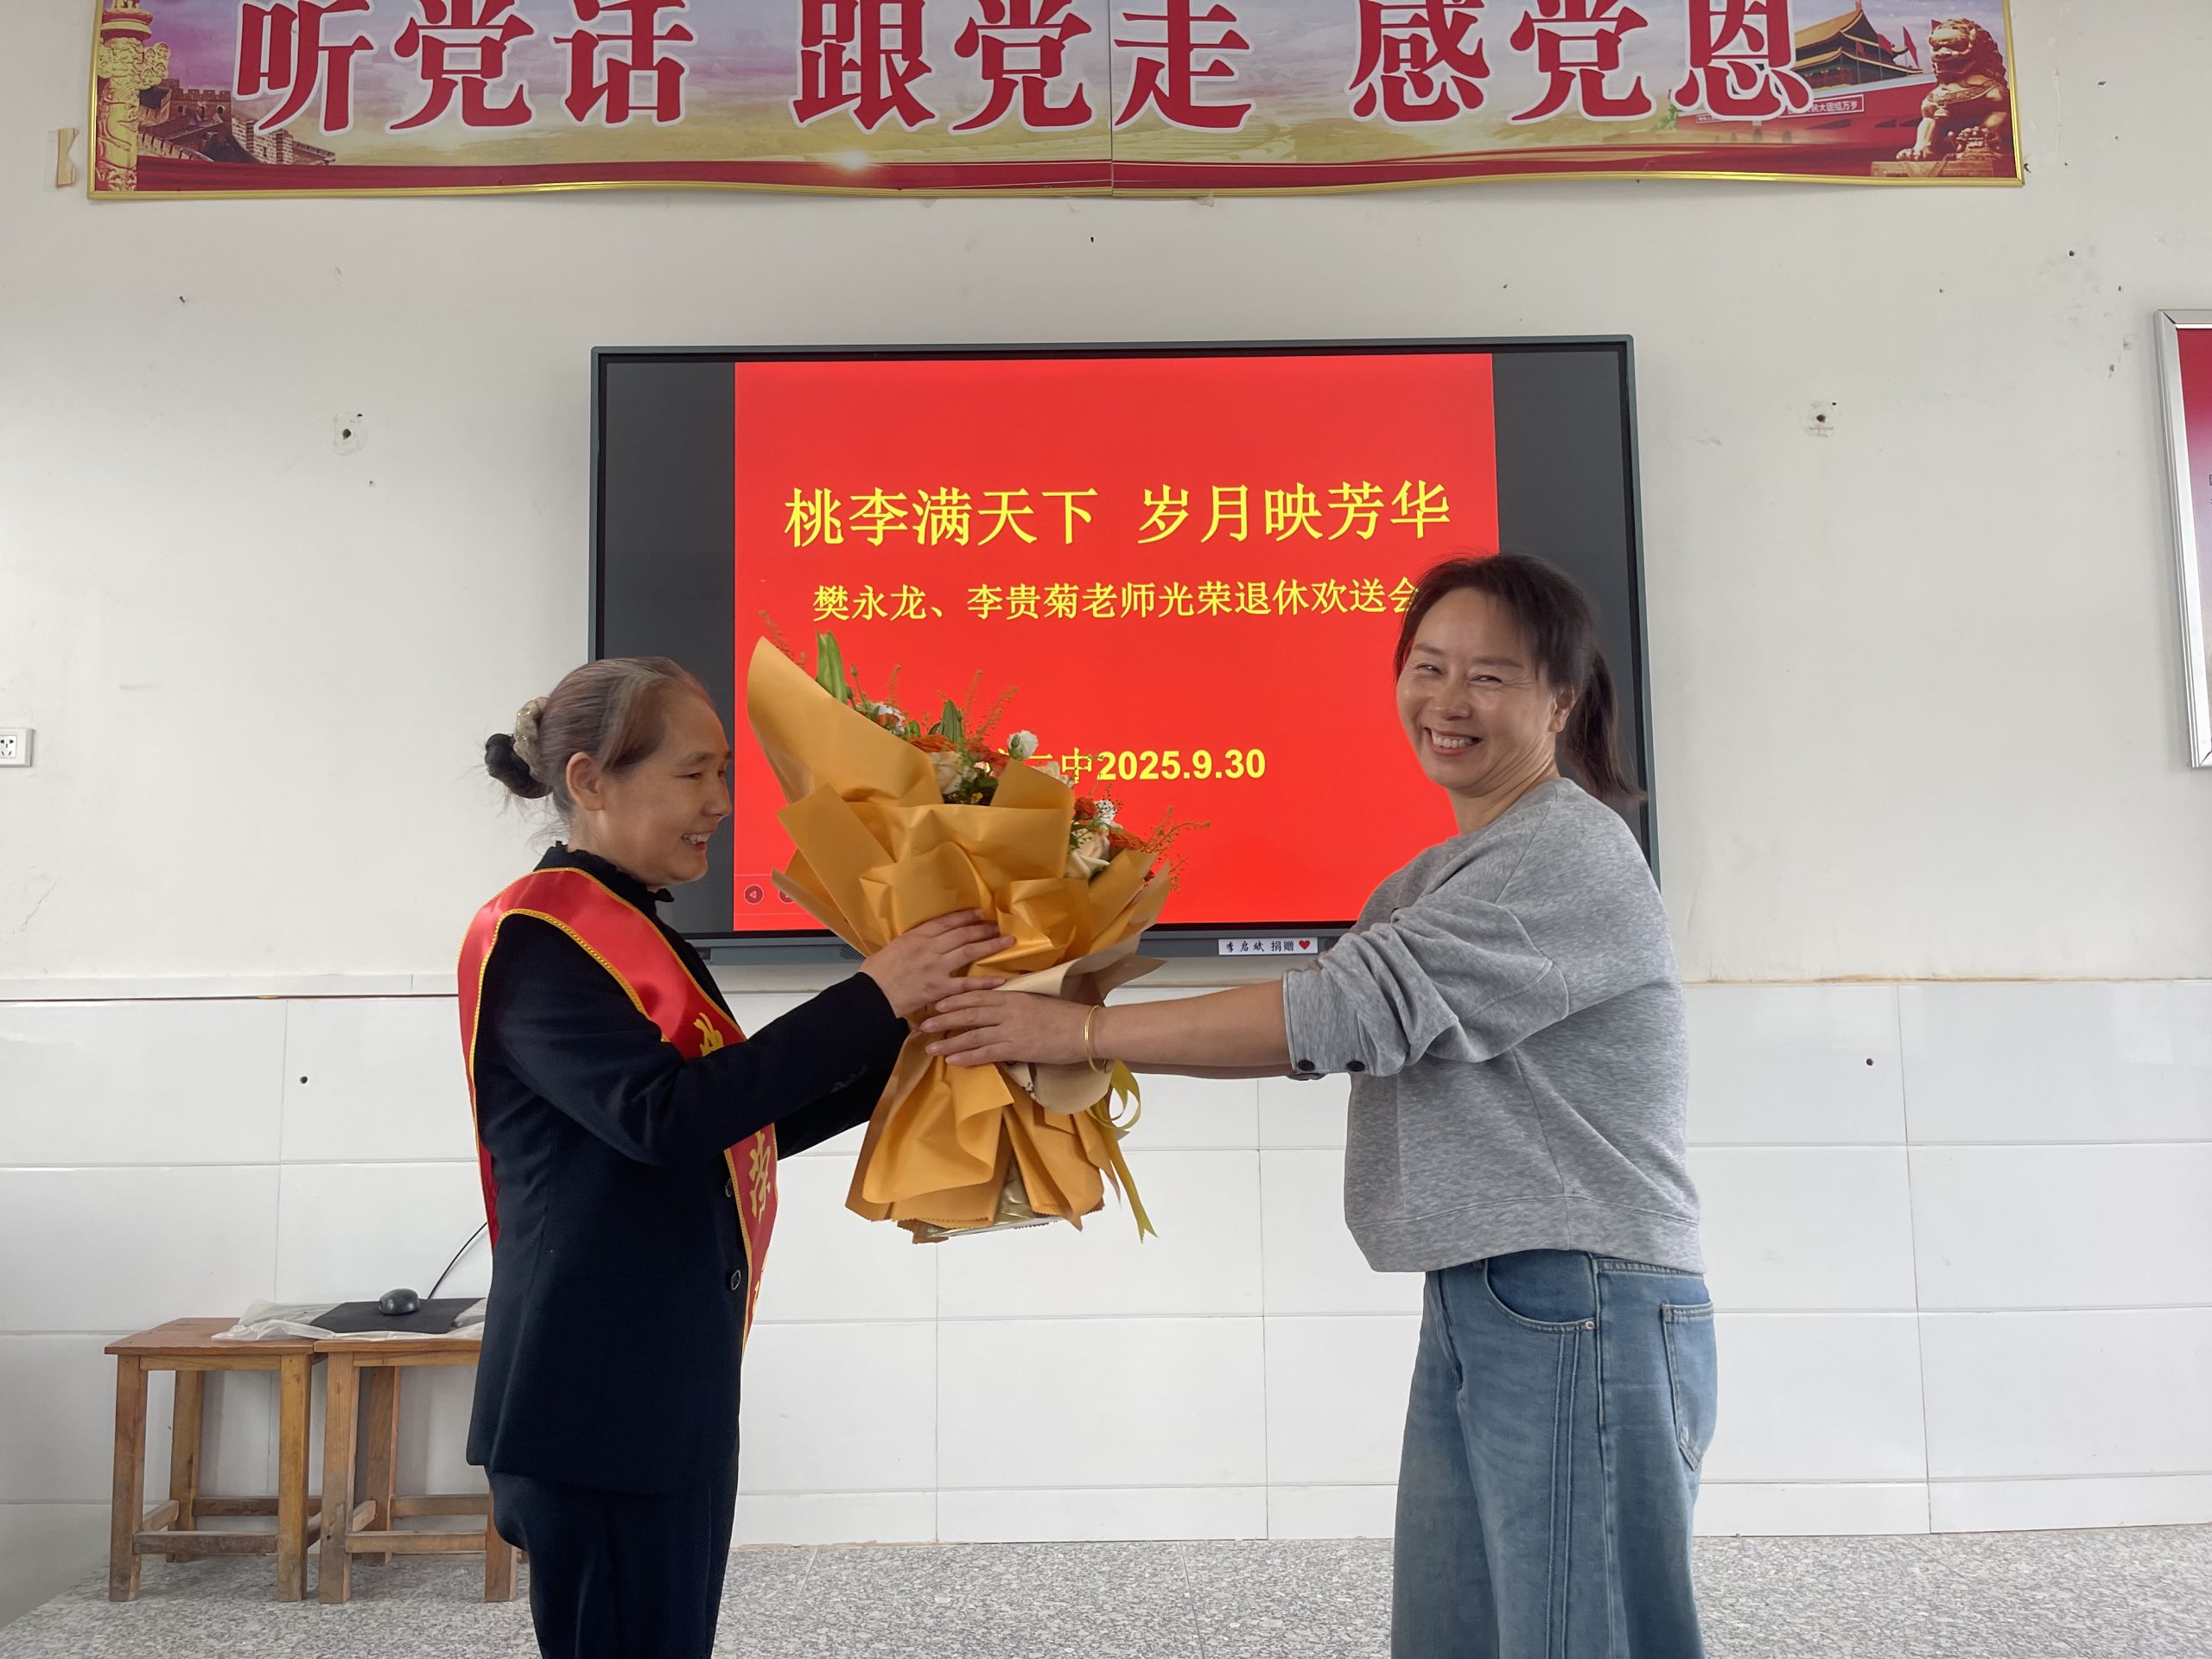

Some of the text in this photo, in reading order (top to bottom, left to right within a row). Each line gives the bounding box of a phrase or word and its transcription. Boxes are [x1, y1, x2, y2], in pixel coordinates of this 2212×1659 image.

[234, 0, 1811, 132] 听党话 跟党走 感党恩
[1807, 99, 1858, 113] 民大团结万岁
[784, 480, 1451, 547] 桃李满天下 岁月映芳华
[812, 576, 1419, 621] 樊永龙、李贵菊老师光荣退休欢送会
[998, 747, 1266, 785] 中2025.9.30
[1271, 940, 1294, 952] 捐赠
